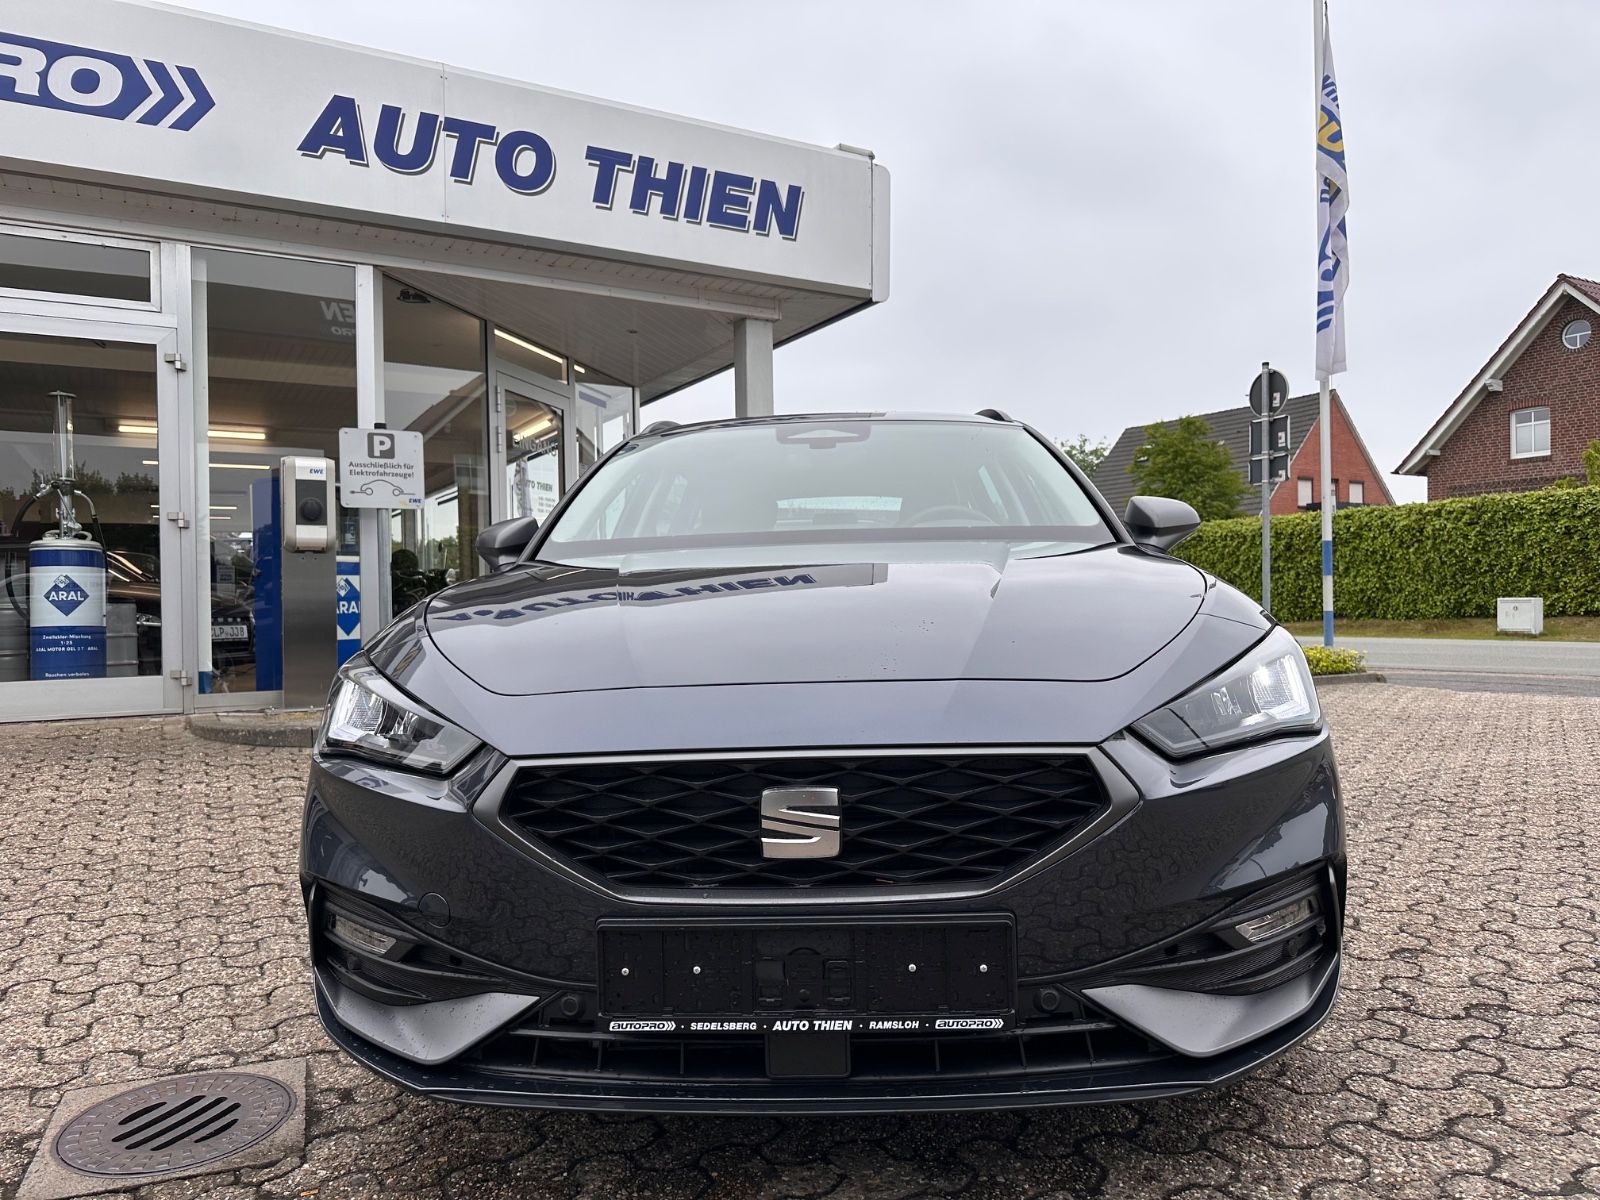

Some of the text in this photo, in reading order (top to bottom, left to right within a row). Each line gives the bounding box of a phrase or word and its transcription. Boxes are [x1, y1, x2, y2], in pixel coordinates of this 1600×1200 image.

[296, 94, 804, 241] AUTO THIEN
[373, 435, 391, 456] P
[348, 461, 403, 470] Ausschließlich
[349, 469, 414, 479] Elektrofahrzeuge!
[49, 591, 84, 601] ARAL
[336, 601, 360, 614] RA
[690, 1022, 757, 1030] SEDELSBERG
[772, 1020, 809, 1031] AUTO
[813, 1020, 853, 1031] THIEN
[869, 1020, 919, 1030] RAMSLOH
